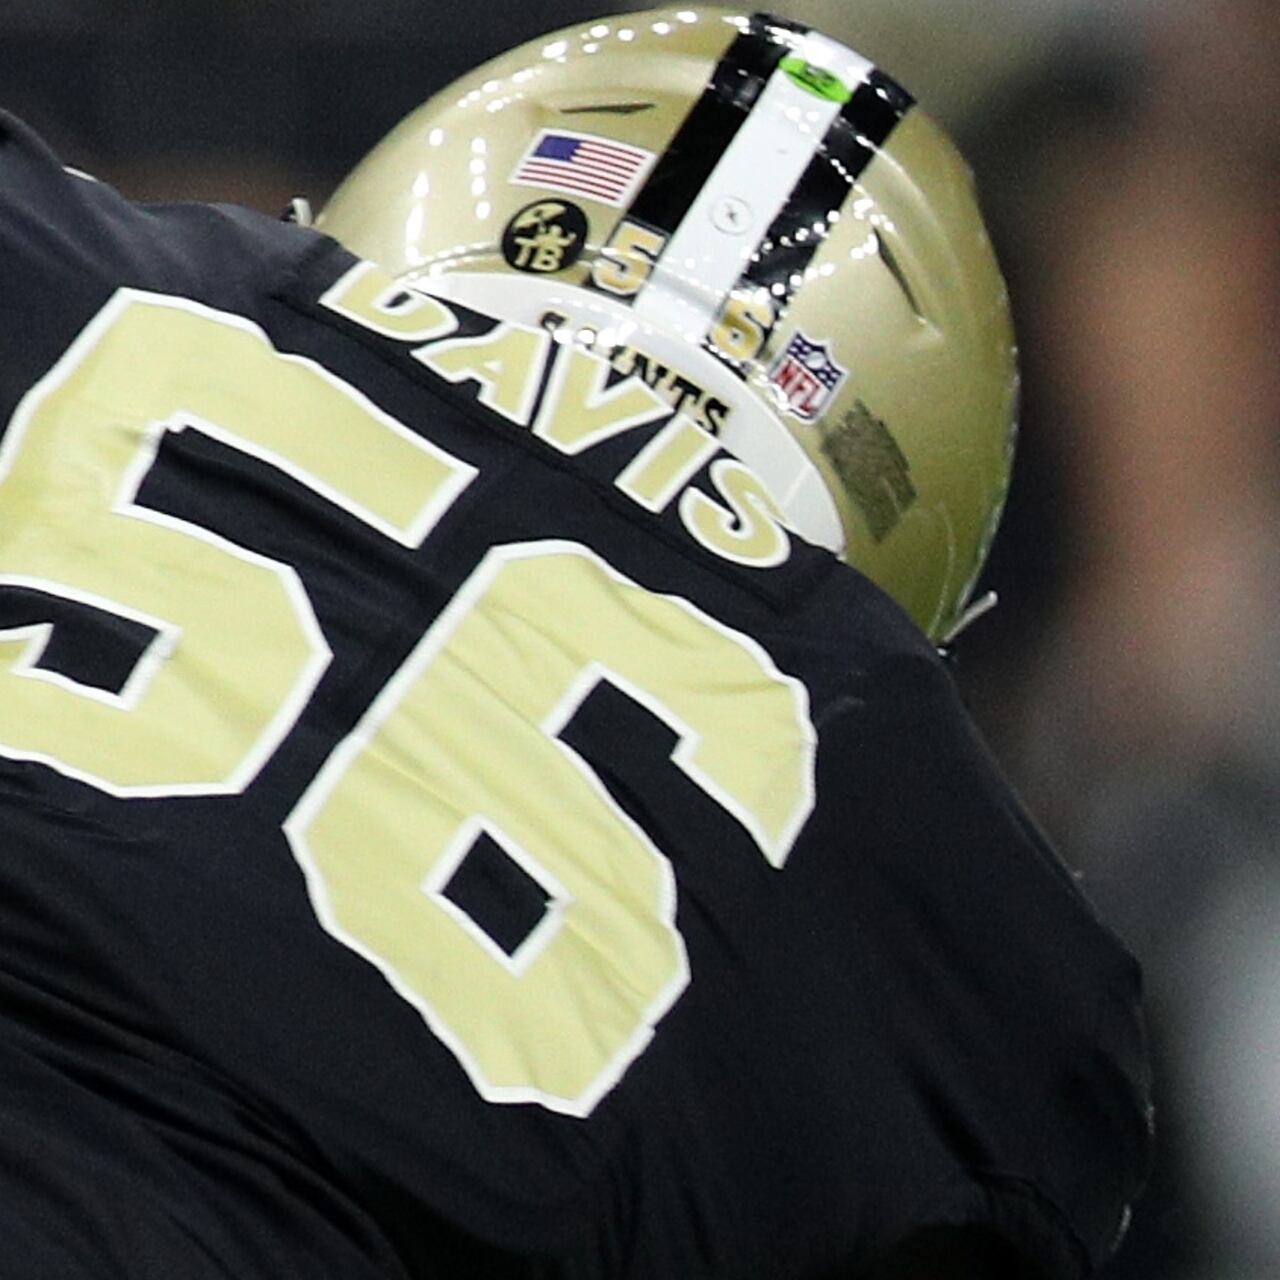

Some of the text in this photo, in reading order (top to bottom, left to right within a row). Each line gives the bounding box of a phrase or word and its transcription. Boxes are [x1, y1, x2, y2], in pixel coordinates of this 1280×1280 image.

[514, 236, 564, 272] TB
[591, 220, 776, 365] 5 6
[318, 260, 792, 568] DAVIS
[772, 359, 822, 414] NFL
